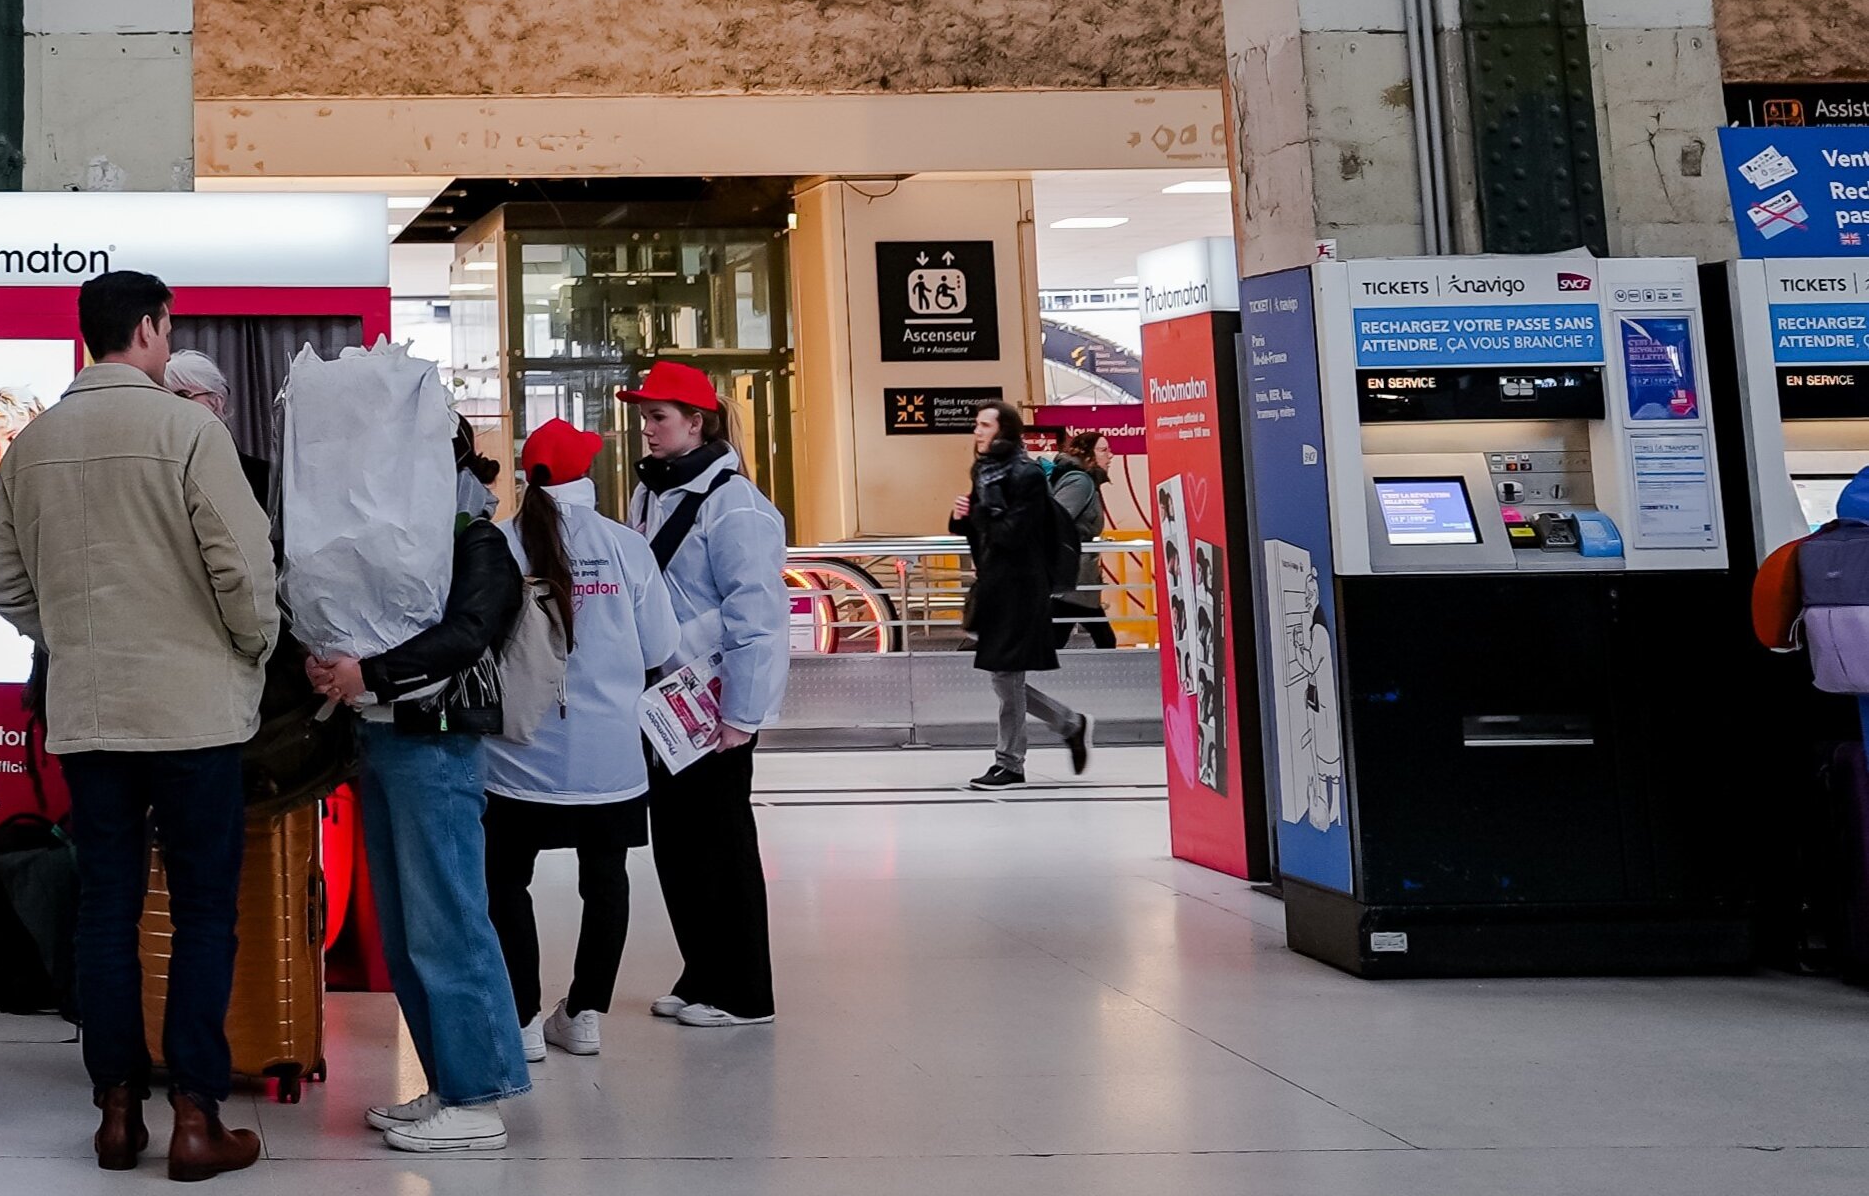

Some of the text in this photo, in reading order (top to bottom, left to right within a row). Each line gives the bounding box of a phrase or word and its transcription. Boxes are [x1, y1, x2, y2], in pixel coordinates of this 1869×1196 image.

[1362, 281, 1429, 295] TICKETS
[1557, 279, 1591, 291] SNCF
[1780, 278, 1847, 292] TICKETS
[1361, 316, 1594, 335] RECHARGEZ VOTRE PASSE SANS
[1778, 316, 1866, 330] RECHARGEZ
[903, 328, 977, 342] Ascenseur
[1779, 335, 1860, 349] ATTENDRE,
[1362, 334, 1594, 354] ATTENDRE, ÇA VOUS BRANCHE ?
[1368, 377, 1436, 389] EN SERVICE
[1786, 374, 1854, 386] EN SERVICE
[1150, 376, 1207, 404] Photomaton
[573, 581, 619, 595] maton
